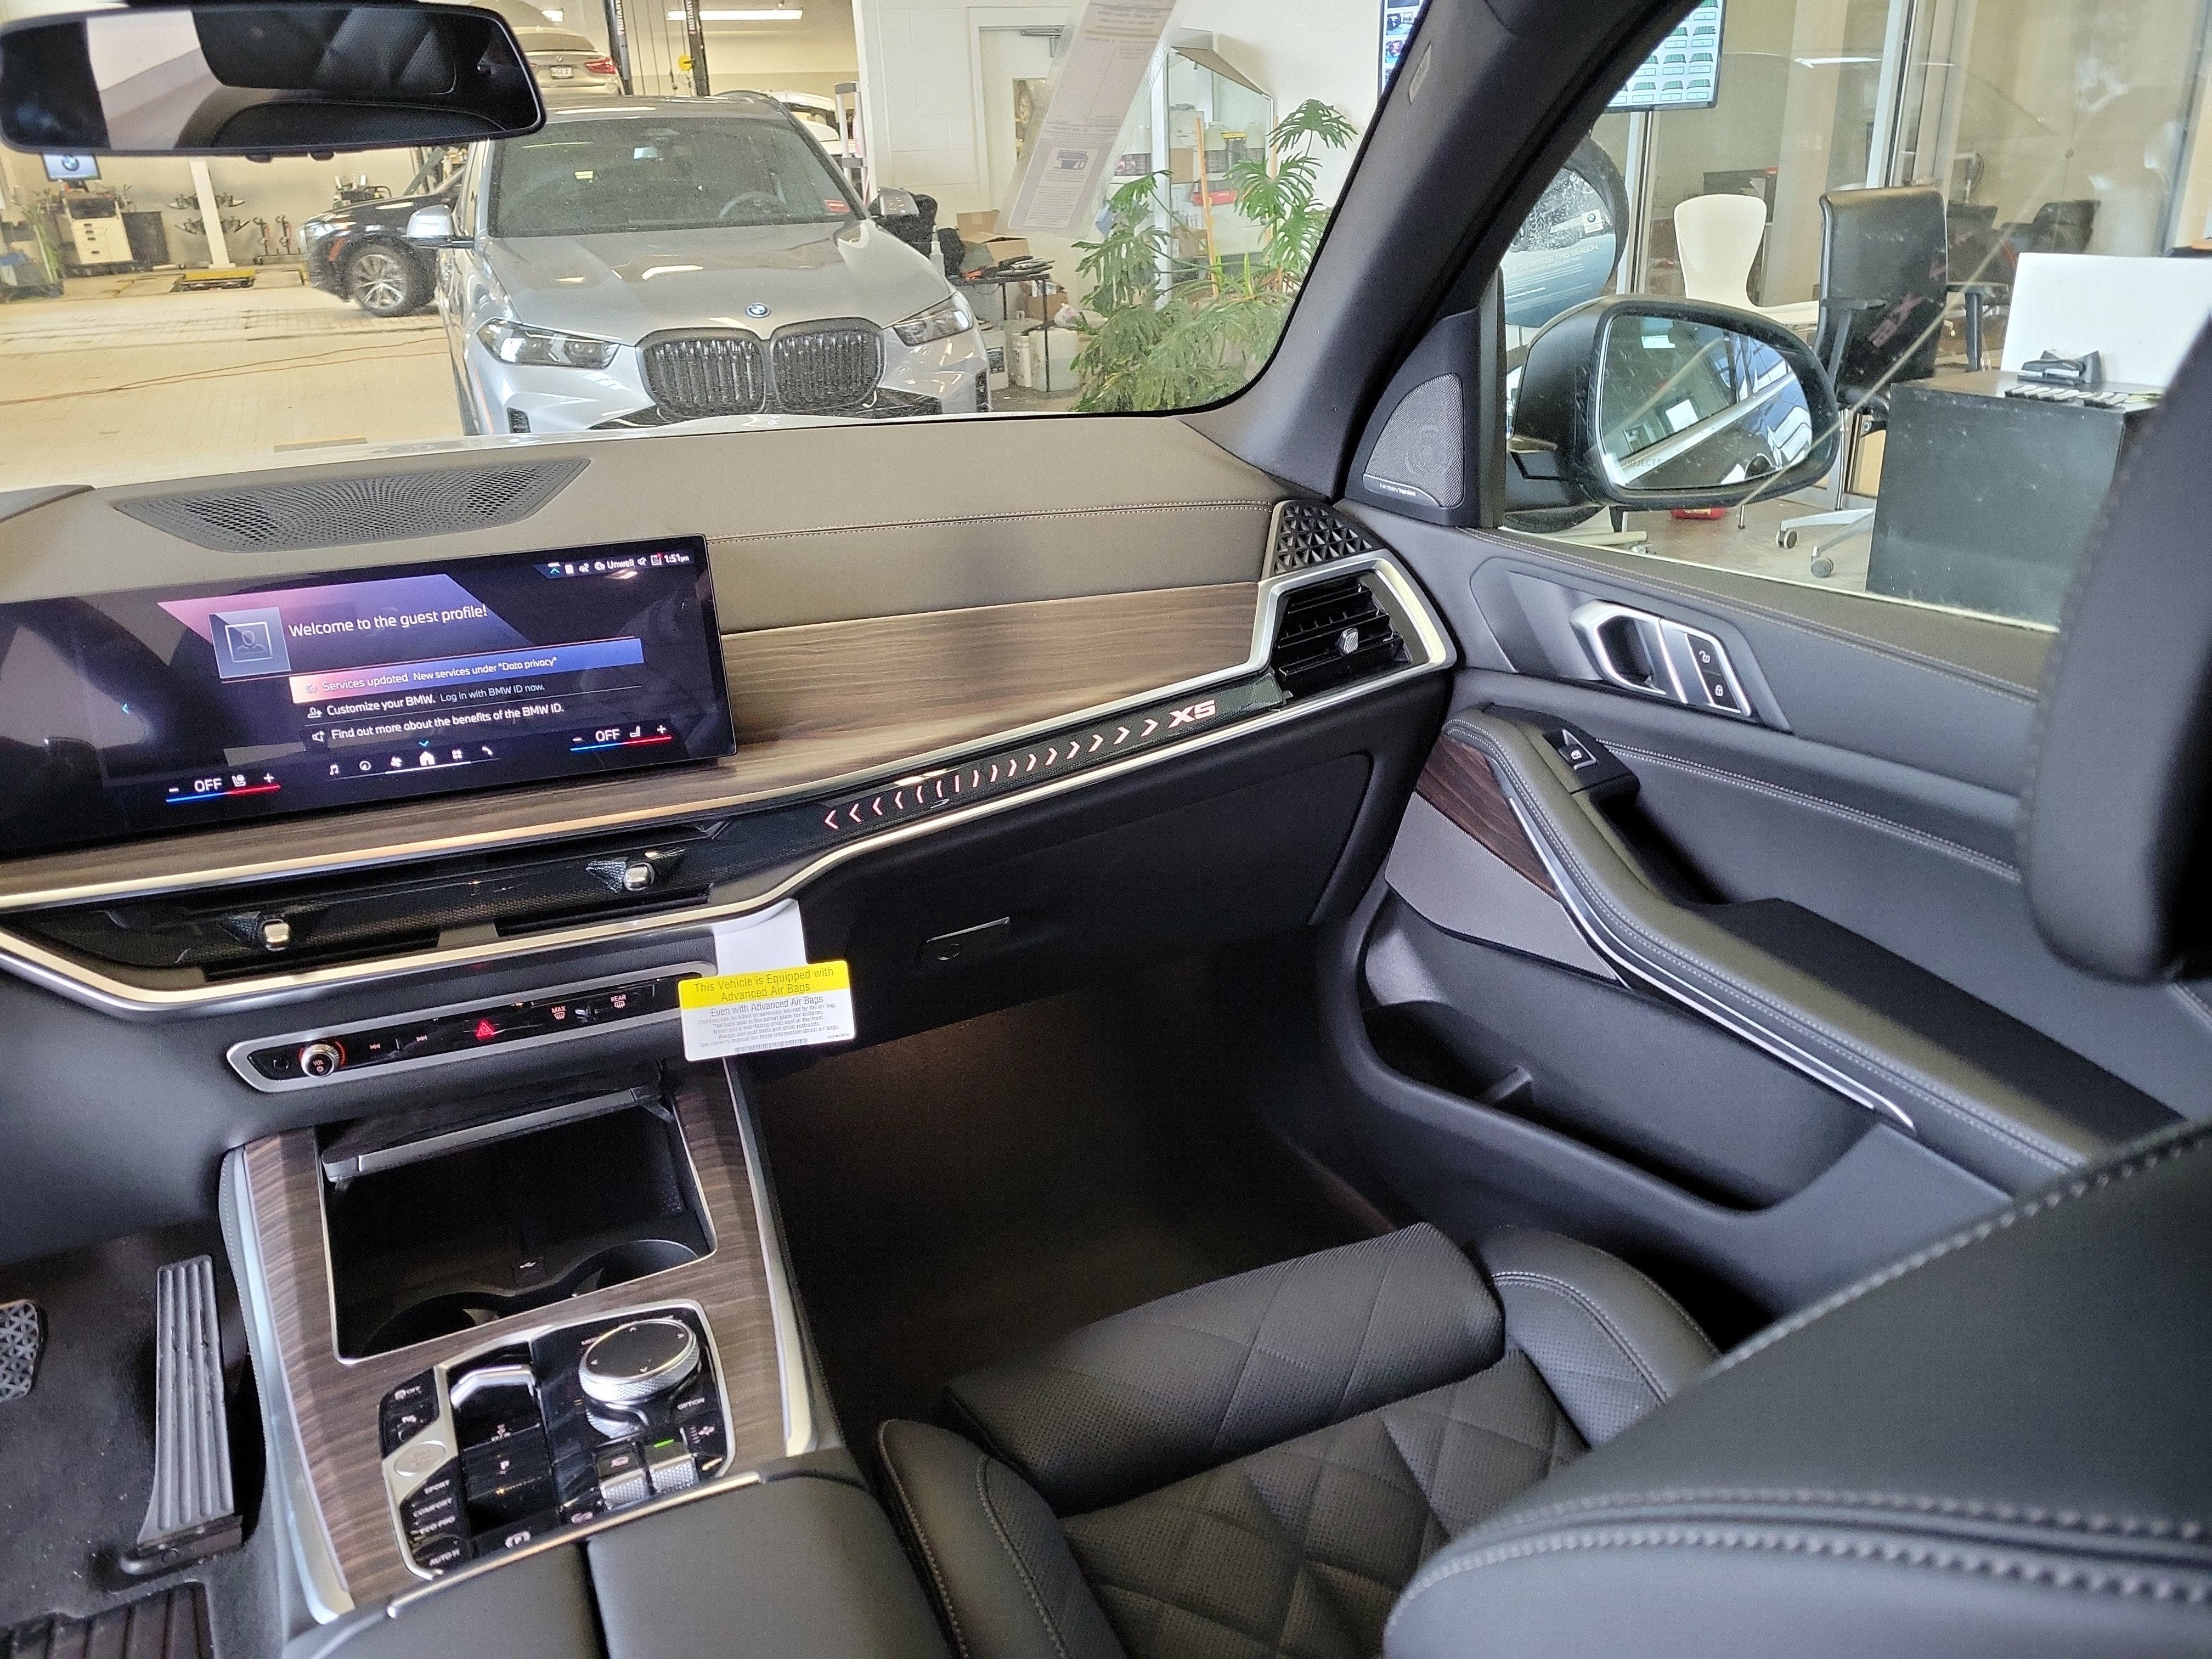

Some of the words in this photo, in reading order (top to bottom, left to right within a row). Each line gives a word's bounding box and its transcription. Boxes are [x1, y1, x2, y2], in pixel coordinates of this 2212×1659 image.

[607, 558, 634, 569] Unwell
[664, 554, 689, 563] 1:51pm
[289, 620, 354, 637] Welcome
[357, 619, 371, 630] to
[374, 615, 397, 628] the
[400, 610, 439, 628] guest
[441, 603, 488, 623] profile!
[322, 680, 365, 692] Services
[368, 673, 409, 687] updated
[413, 671, 433, 681] New
[435, 667, 471, 679] services
[472, 664, 496, 674] under
[498, 662, 523, 671] "Data
[524, 656, 557, 670] privacy"
[326, 701, 380, 715] Customize
[381, 699, 404, 711] your
[405, 693, 436, 707] BMW.
[439, 693, 458, 703] Log
[469, 689, 487, 699] with
[488, 686, 511, 696] BMW
[513, 685, 523, 693] ID
[524, 684, 545, 692] now.
[331, 727, 355, 740] Find
[356, 726, 374, 737] out
[375, 724, 402, 734] more
[403, 720, 432, 731] about
[434, 718, 450, 727] the
[452, 712, 492, 725] benefits
[493, 709, 504, 720] of
[504, 709, 521, 719] the
[522, 704, 549, 716] BMW
[550, 703, 565, 713] ID.
[1168, 699, 1216, 729] X5
[595, 729, 620, 742] OFF
[194, 777, 222, 792] OFF
[694, 982, 715, 993] This
[717, 977, 753, 990] Vehicle
[756, 975, 764, 985] is
[766, 969, 810, 985] Equipped
[814, 967, 834, 978] with
[610, 994, 627, 1003] REAR
[721, 987, 768, 1002] Advanced
[771, 986, 785, 996] Air
[787, 983, 811, 994] Bags
[551, 1005, 566, 1014] MAX
[711, 1008, 730, 1017] Even
[732, 1005, 749, 1014] with
[752, 998, 789, 1012] Advanced
[791, 997, 802, 1007] Air
[804, 996, 823, 1005] Bags
[676, 1397, 706, 1410] OPTION
[424, 1479, 450, 1495] SPORT
